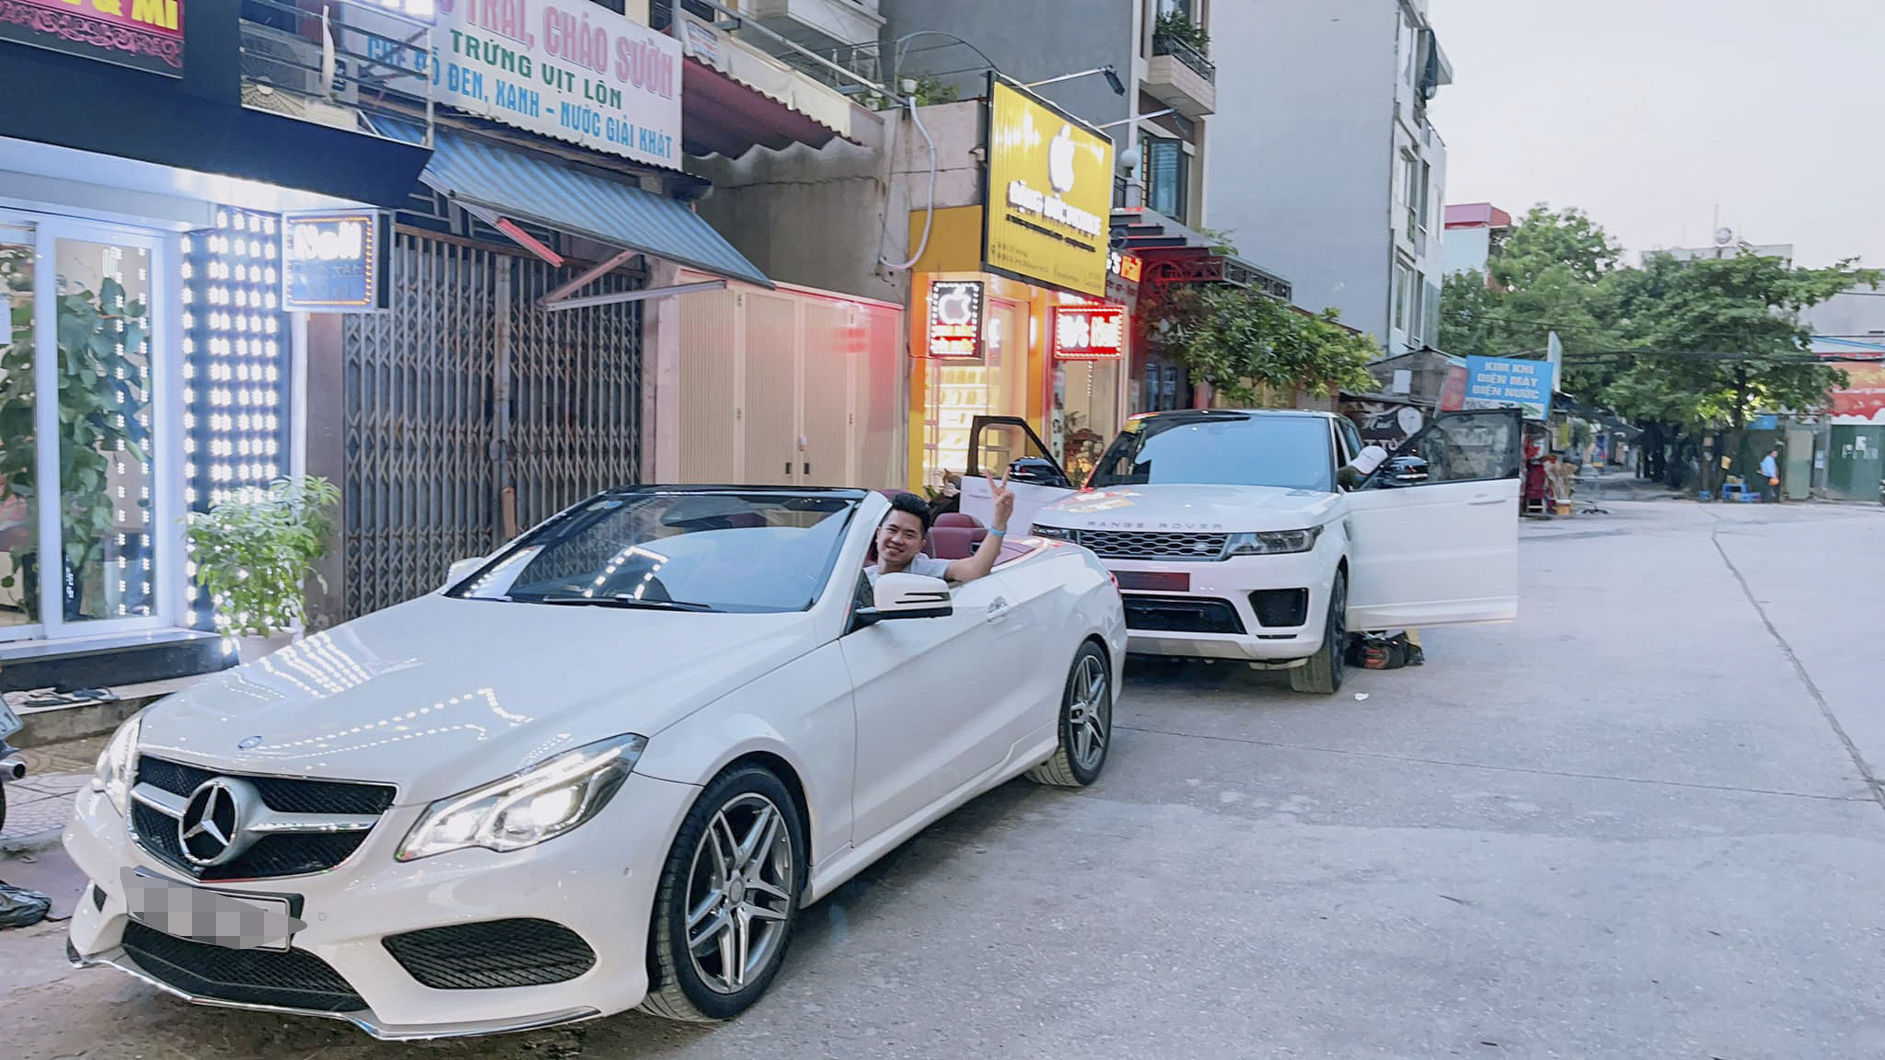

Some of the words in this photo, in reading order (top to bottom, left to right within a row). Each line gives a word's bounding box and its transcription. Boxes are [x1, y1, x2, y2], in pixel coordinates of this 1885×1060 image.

[449, 28, 532, 79] TRỨNG
[542, 62, 575, 94] VỊT
[584, 79, 622, 110] LỘN
[544, 6, 608, 74] CHÁO
[495, 79, 539, 118] XANH
[561, 101, 601, 138] NƯỚC
[606, 114, 634, 148] GIẢI
[639, 128, 672, 159] KHÁT
[1158, 522, 1223, 530] ROVER
